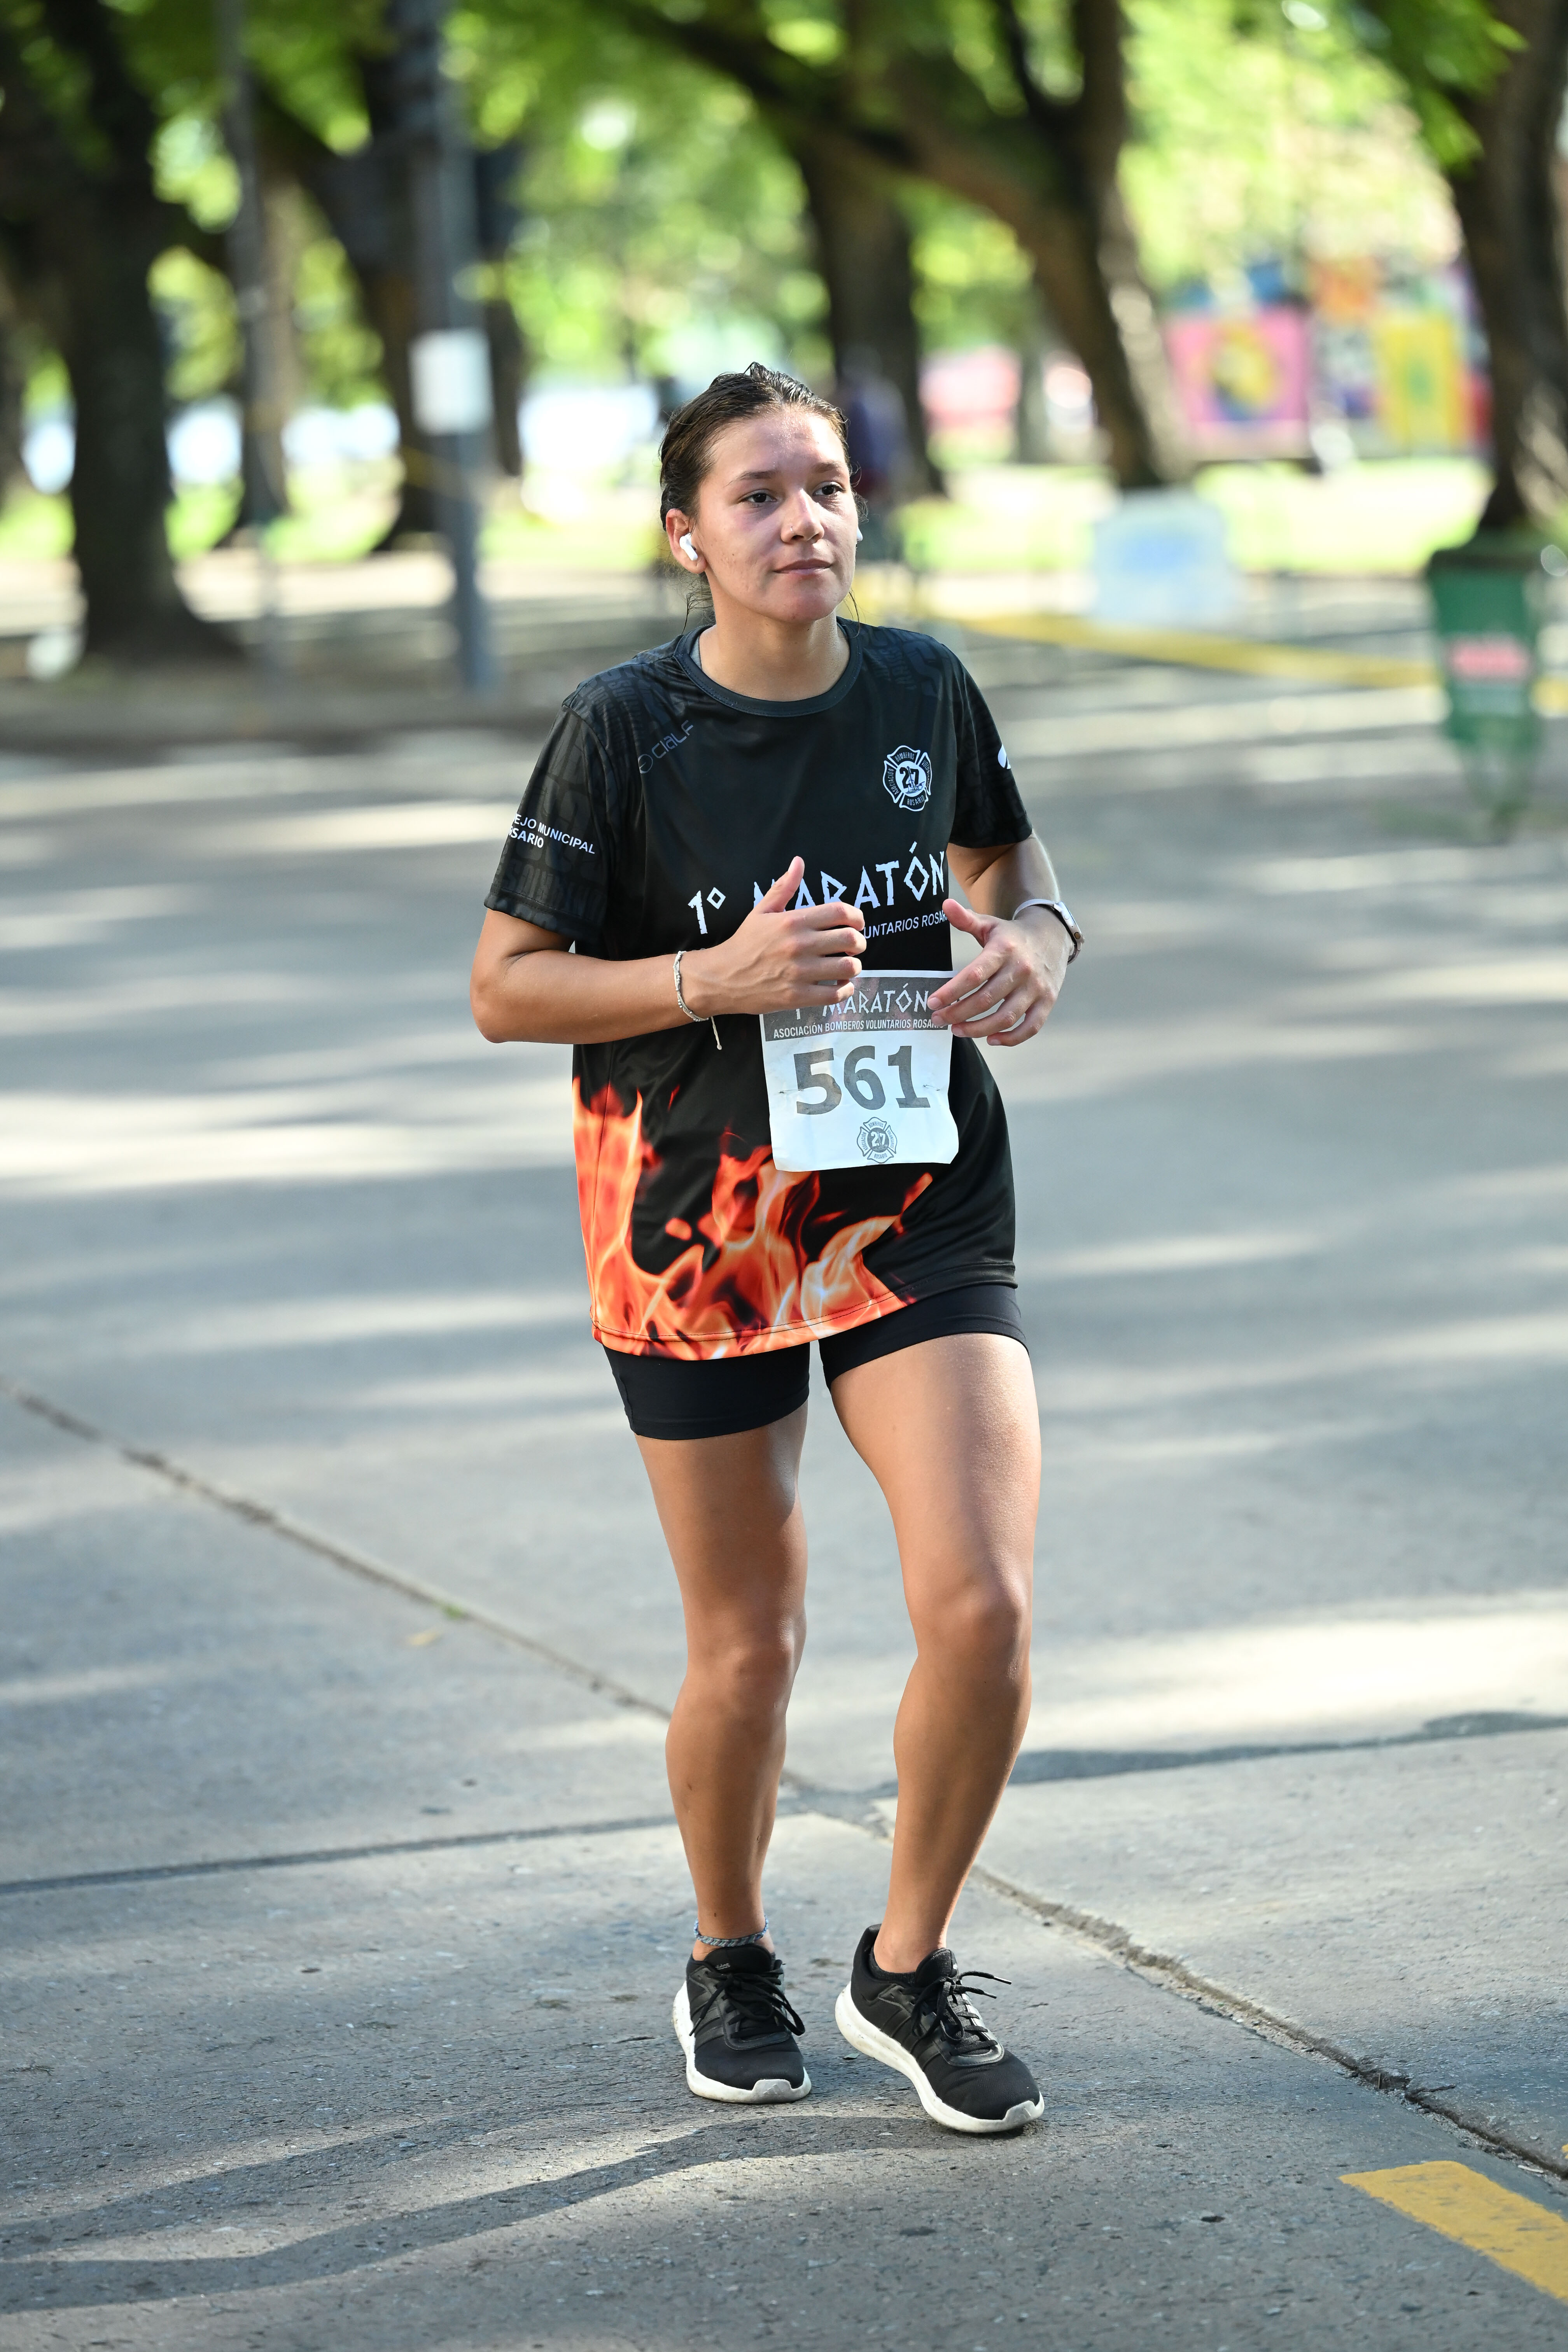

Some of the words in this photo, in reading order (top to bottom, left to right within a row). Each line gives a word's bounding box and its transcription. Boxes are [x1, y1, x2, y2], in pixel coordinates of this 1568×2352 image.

[894, 752, 914, 762] BOMBEROS
[899, 767, 919, 789] 27
[907, 795, 925, 806] ROSARIO
[537, 822, 595, 854] MUNICIPAL
[922, 910, 947, 927] ROSAR
[774, 1022, 822, 1039] ASOCIACIÓN
[825, 1020, 864, 1031] BOMBEROS
[866, 1019, 911, 1029] VOLUNTARIOS
[794, 1045, 931, 1115] 561
[870, 1131, 886, 1147] 27
